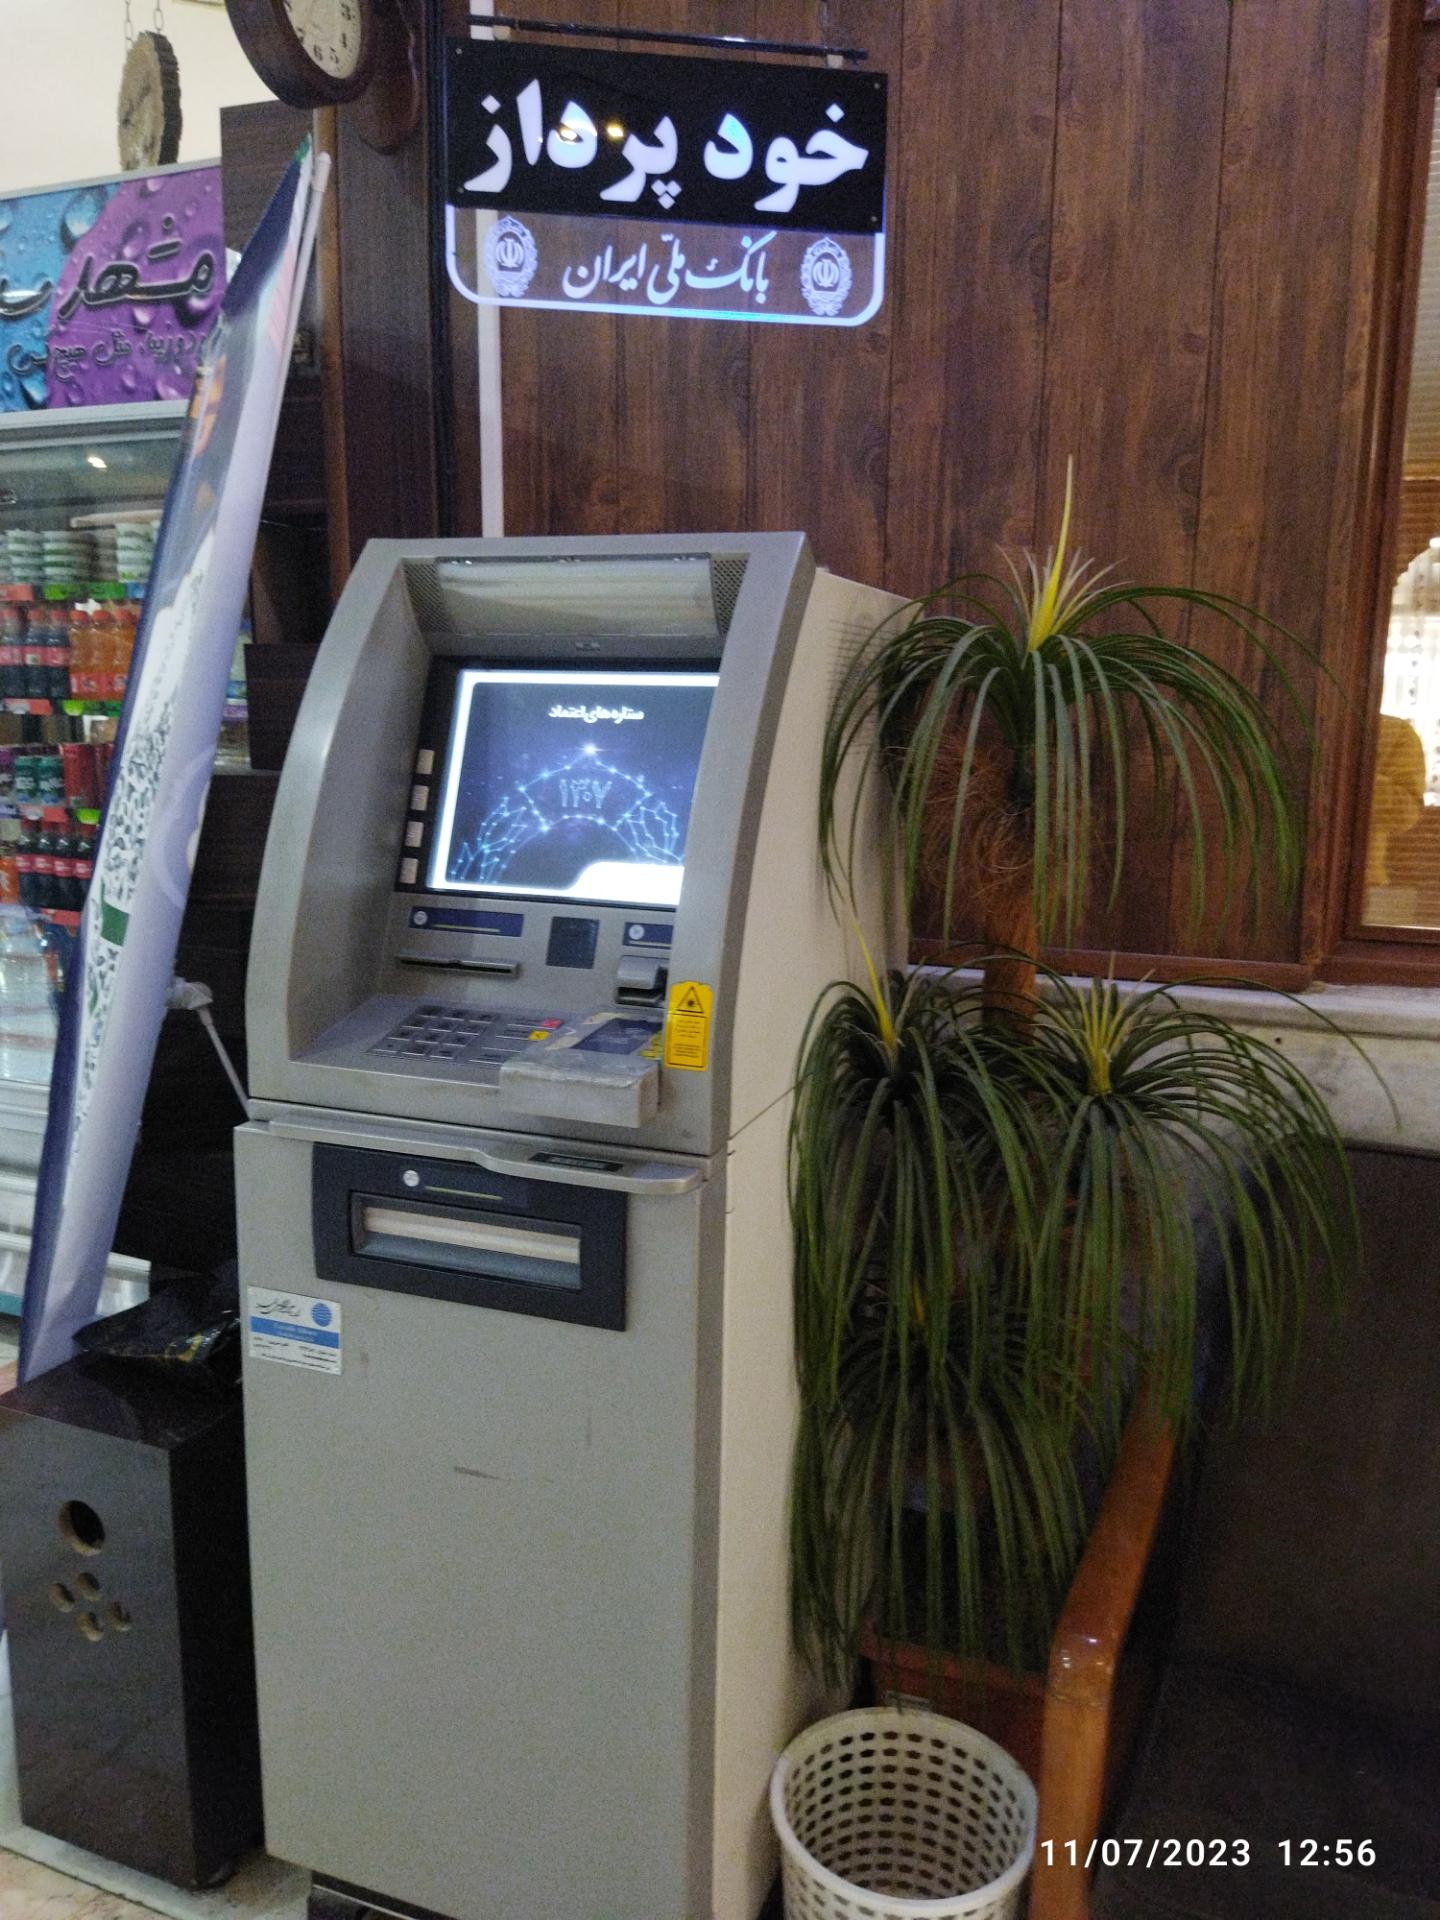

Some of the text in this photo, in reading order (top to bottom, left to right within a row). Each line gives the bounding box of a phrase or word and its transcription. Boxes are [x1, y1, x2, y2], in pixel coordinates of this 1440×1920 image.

[704, 102, 869, 214] خود
[561, 242, 648, 299] ایران
[685, 230, 778, 304] بانک
